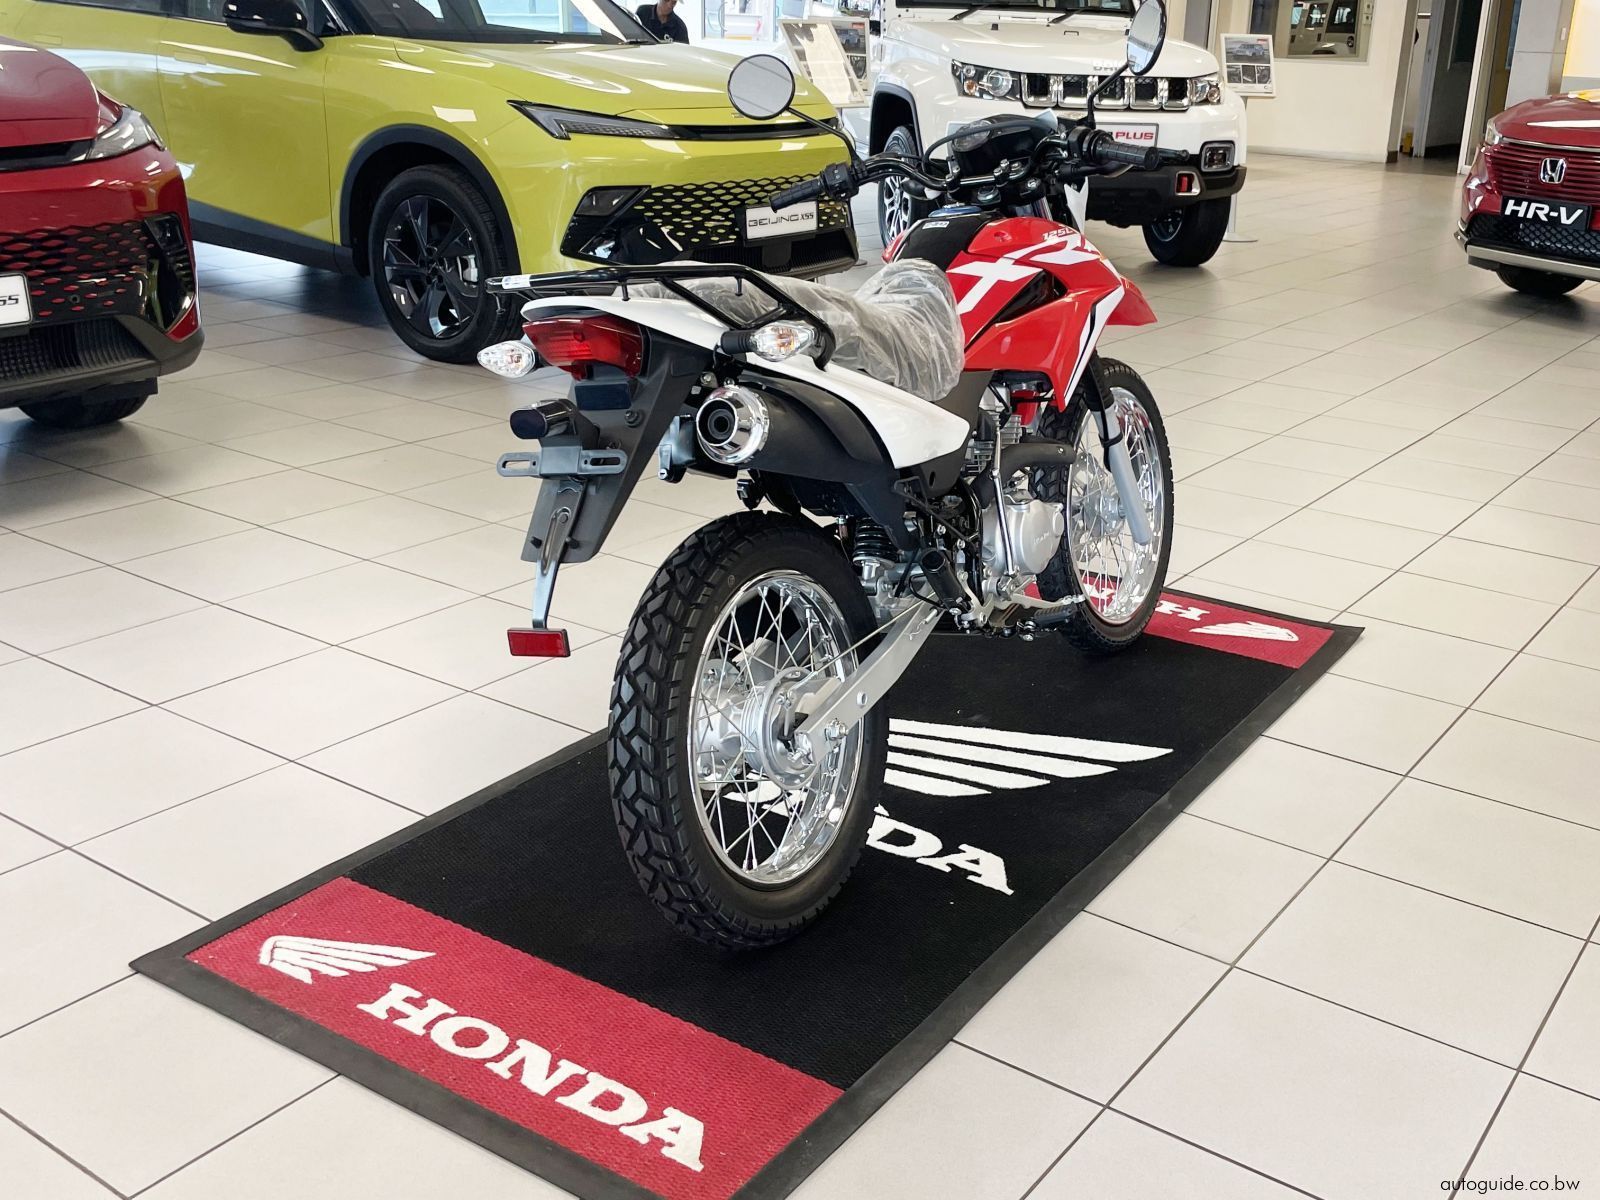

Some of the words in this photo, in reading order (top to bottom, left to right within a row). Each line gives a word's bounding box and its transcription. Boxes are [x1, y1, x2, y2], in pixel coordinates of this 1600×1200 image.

[1115, 131, 1154, 140] PLUS
[1504, 199, 1584, 225] HR-V
[356, 982, 704, 1172] HONDA
